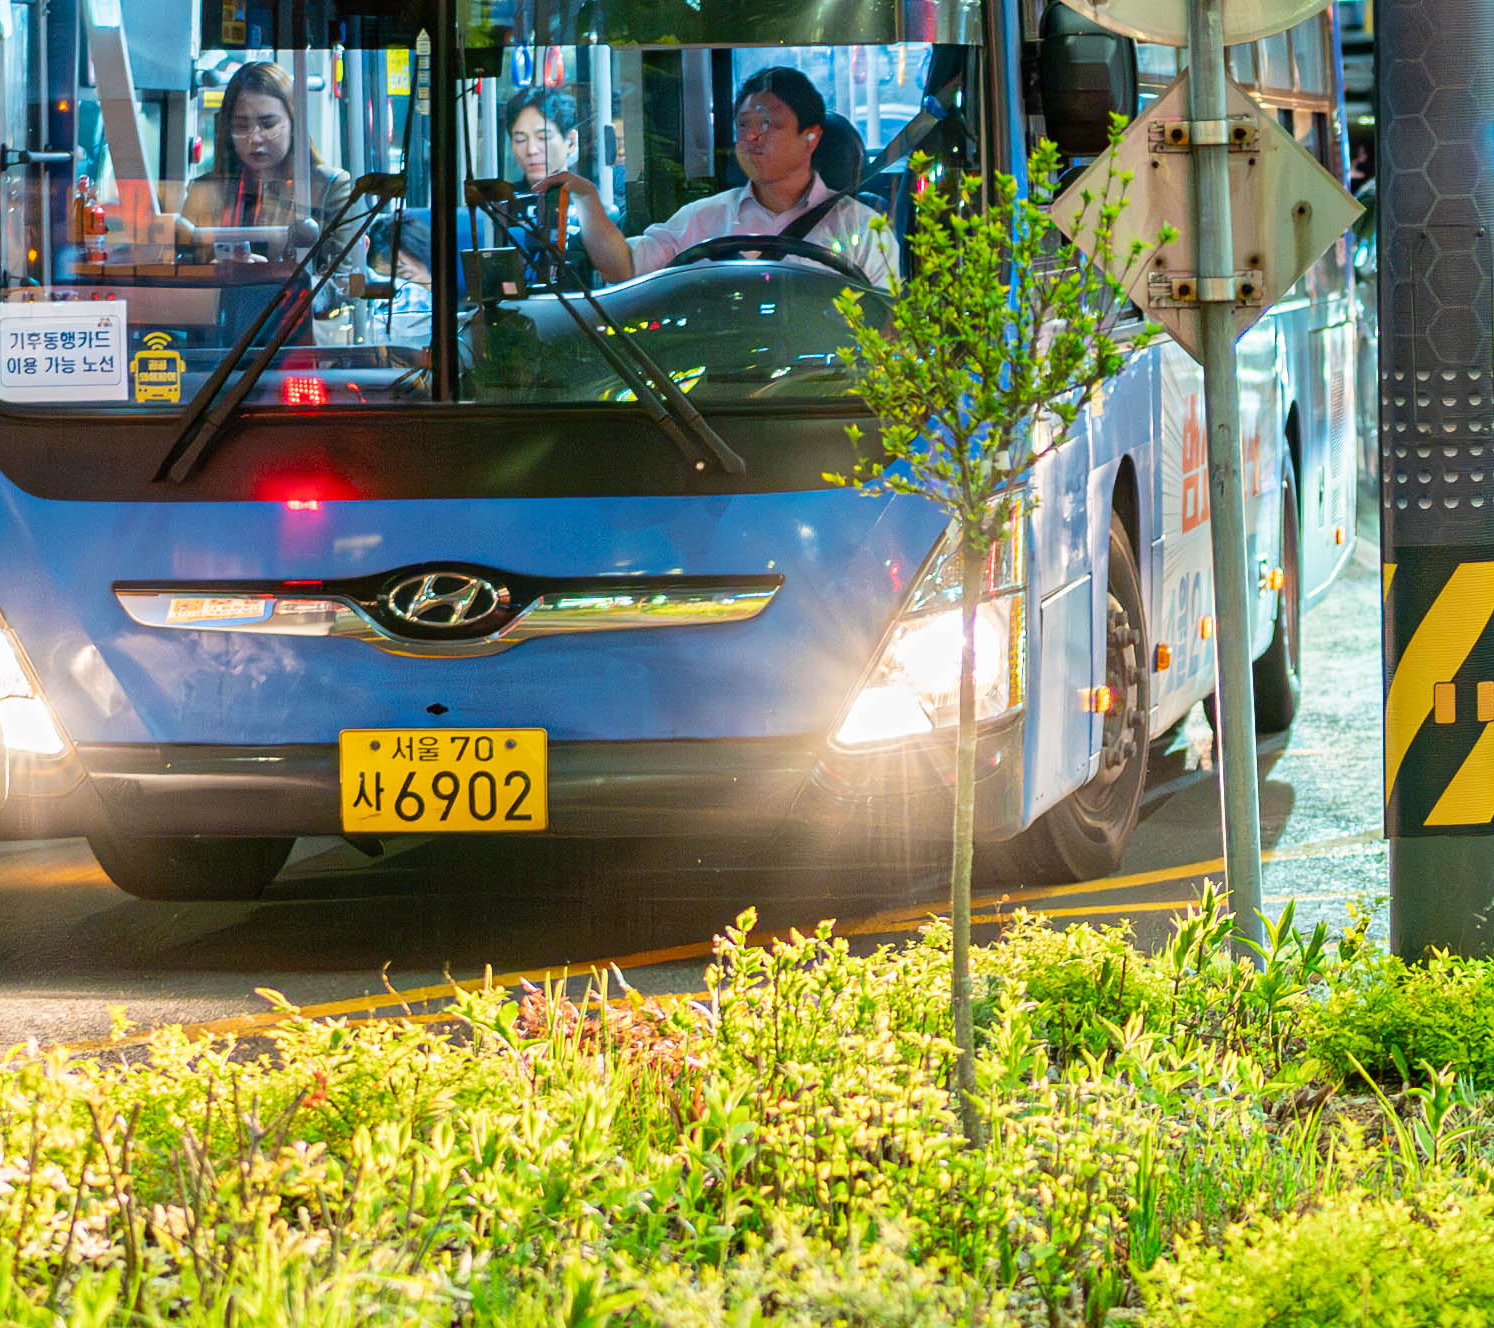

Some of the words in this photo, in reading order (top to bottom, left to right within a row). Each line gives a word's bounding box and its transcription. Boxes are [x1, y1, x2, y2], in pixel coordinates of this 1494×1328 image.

[9, 330, 112, 350] 기후동행카드
[7, 356, 39, 374] 이용
[45, 356, 77, 374] 가능
[82, 355, 115, 373] 노선
[392, 736, 440, 762] 서울
[450, 736, 494, 762] 70
